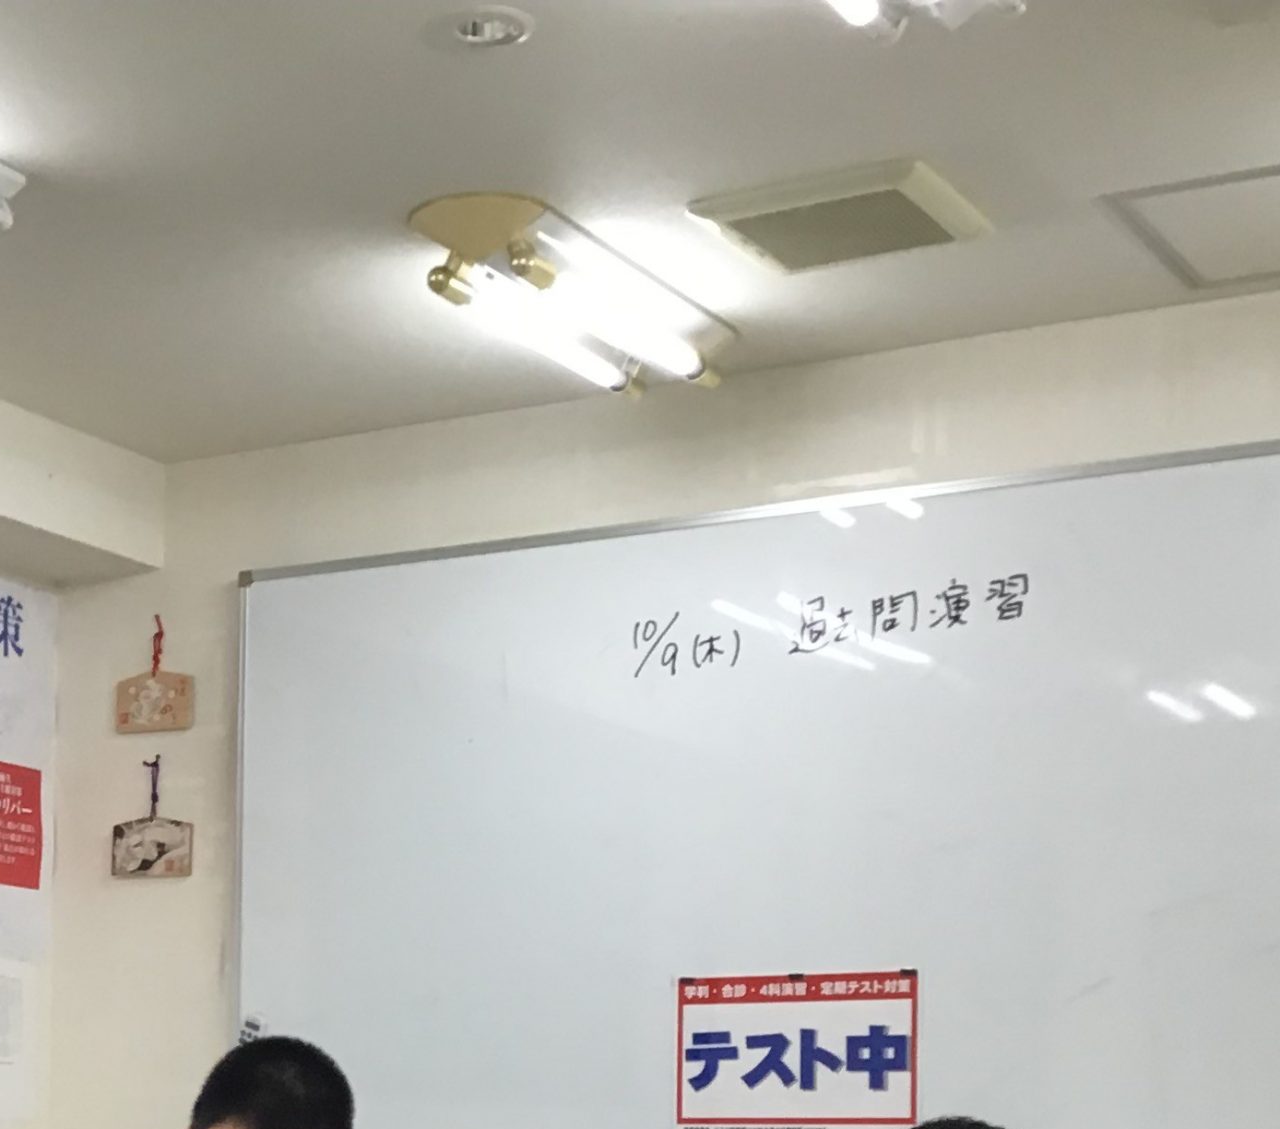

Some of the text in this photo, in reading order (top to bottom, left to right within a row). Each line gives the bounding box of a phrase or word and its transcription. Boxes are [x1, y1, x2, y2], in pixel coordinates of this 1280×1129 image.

[788, 573, 1029, 656] 過去問演習
[684, 1024, 912, 1092] テスト中
